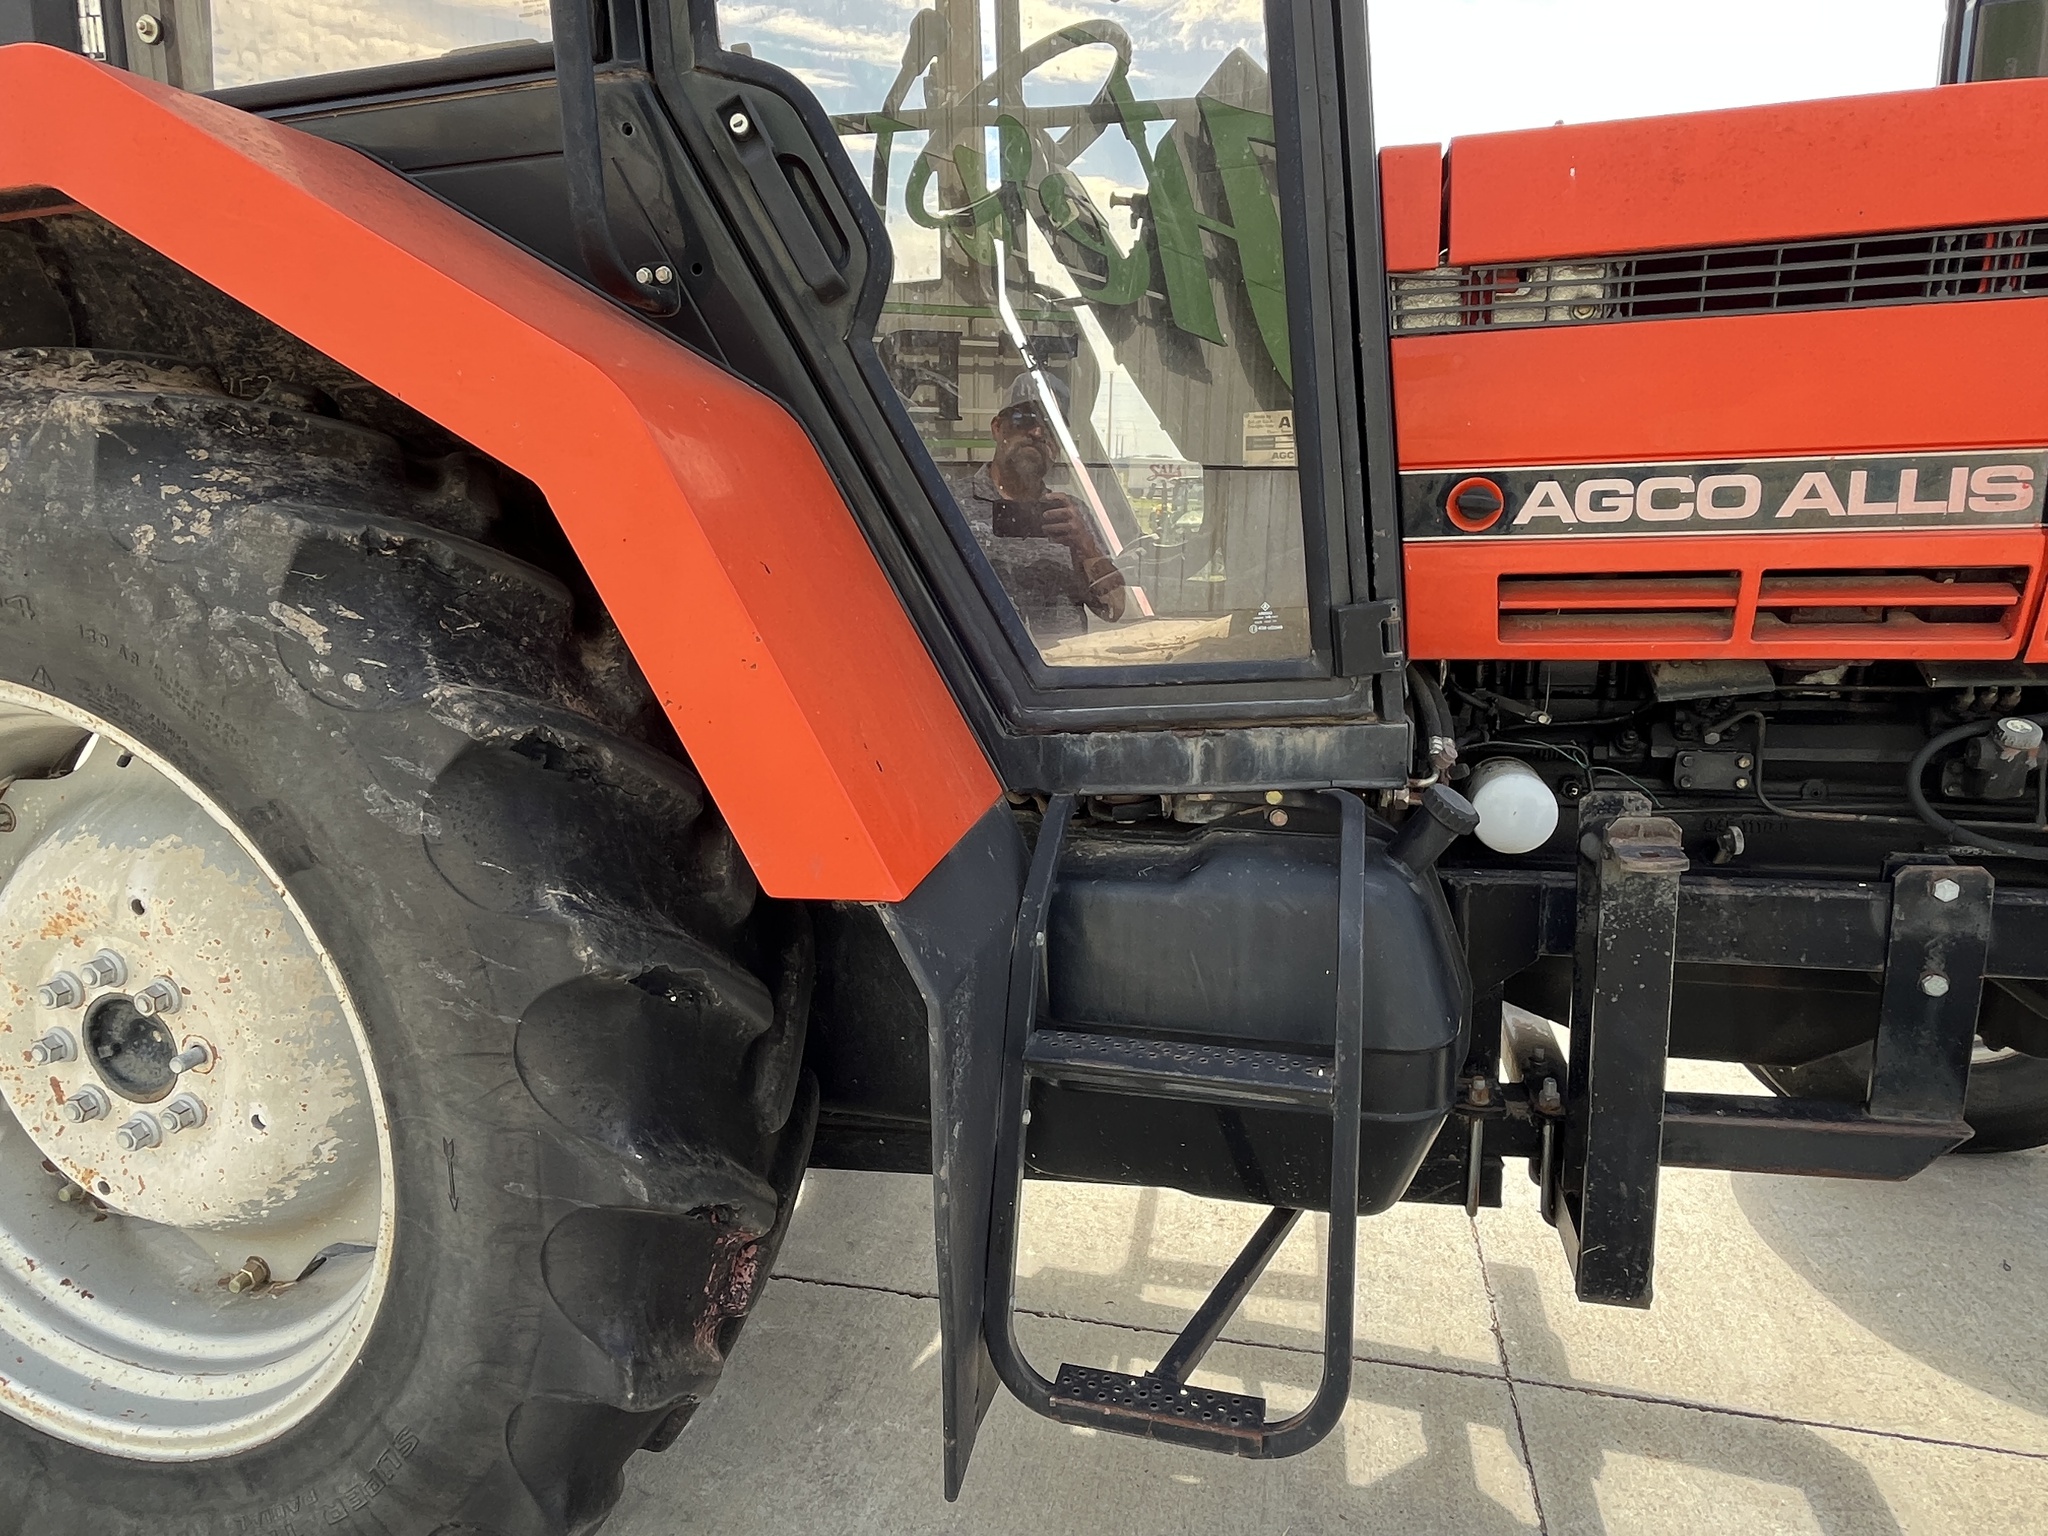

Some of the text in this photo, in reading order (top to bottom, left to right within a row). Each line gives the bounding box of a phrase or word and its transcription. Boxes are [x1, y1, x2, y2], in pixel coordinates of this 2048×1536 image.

[1512, 465, 2035, 525] AGCO ALLIS
[322, 1425, 421, 1526] SUPER
